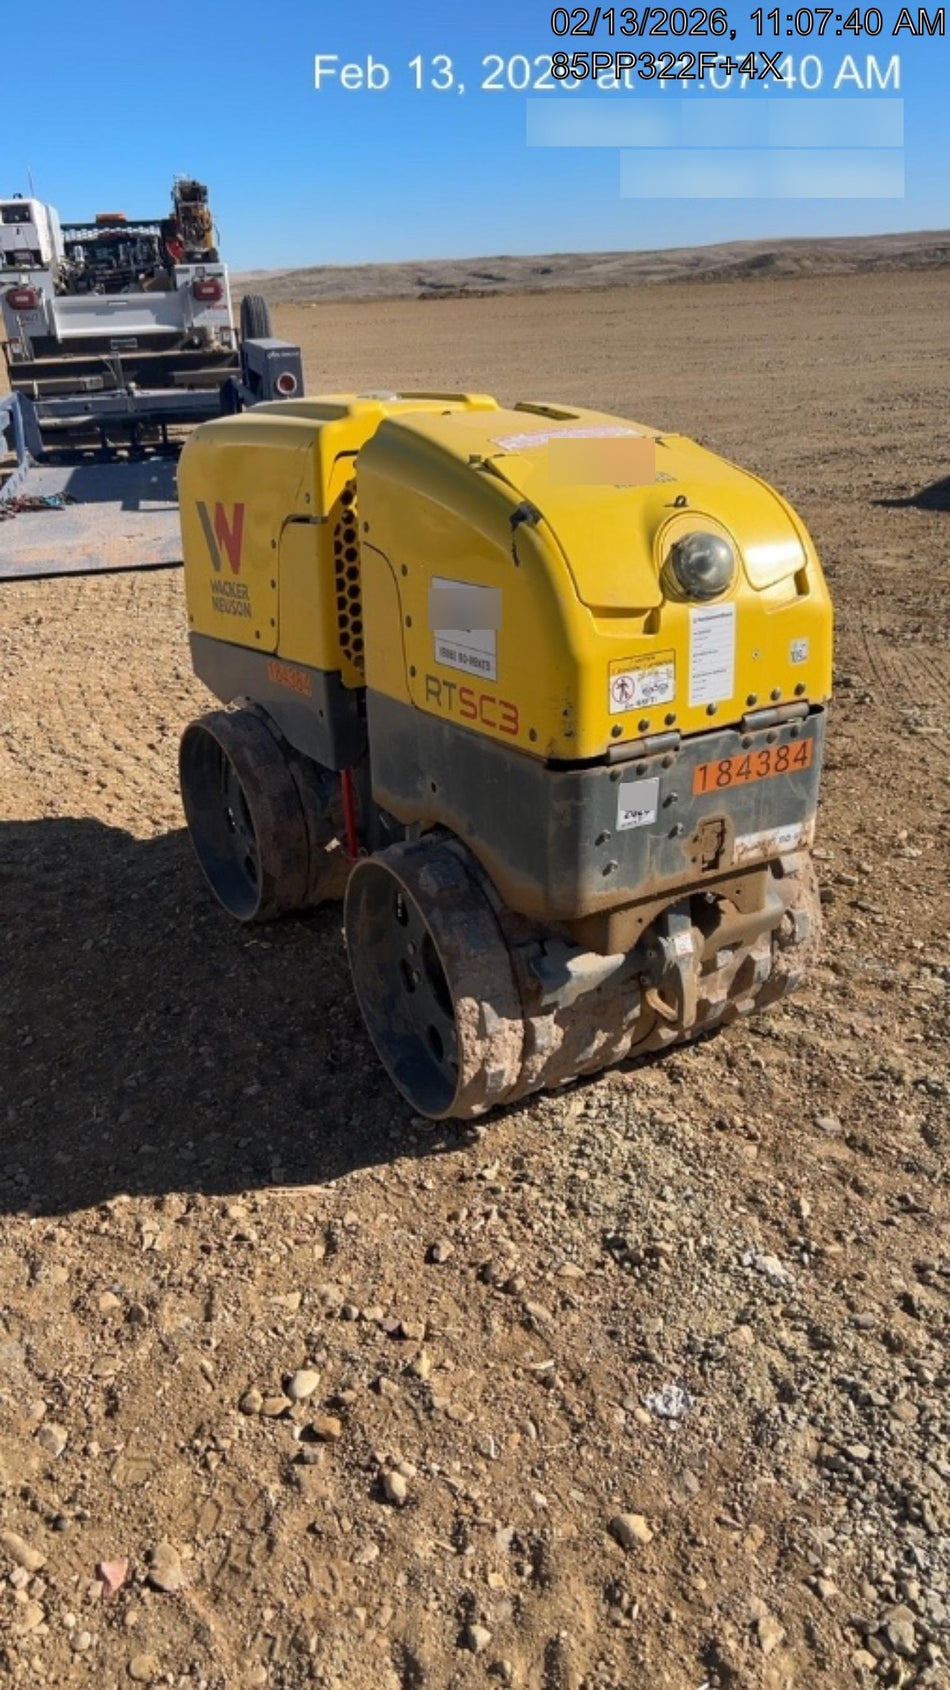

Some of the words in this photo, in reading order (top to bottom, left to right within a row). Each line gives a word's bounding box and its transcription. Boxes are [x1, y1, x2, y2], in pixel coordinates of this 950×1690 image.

[210, 579, 250, 601] WACKER
[211, 596, 252, 619] NEUSON
[698, 741, 808, 791] 184384
